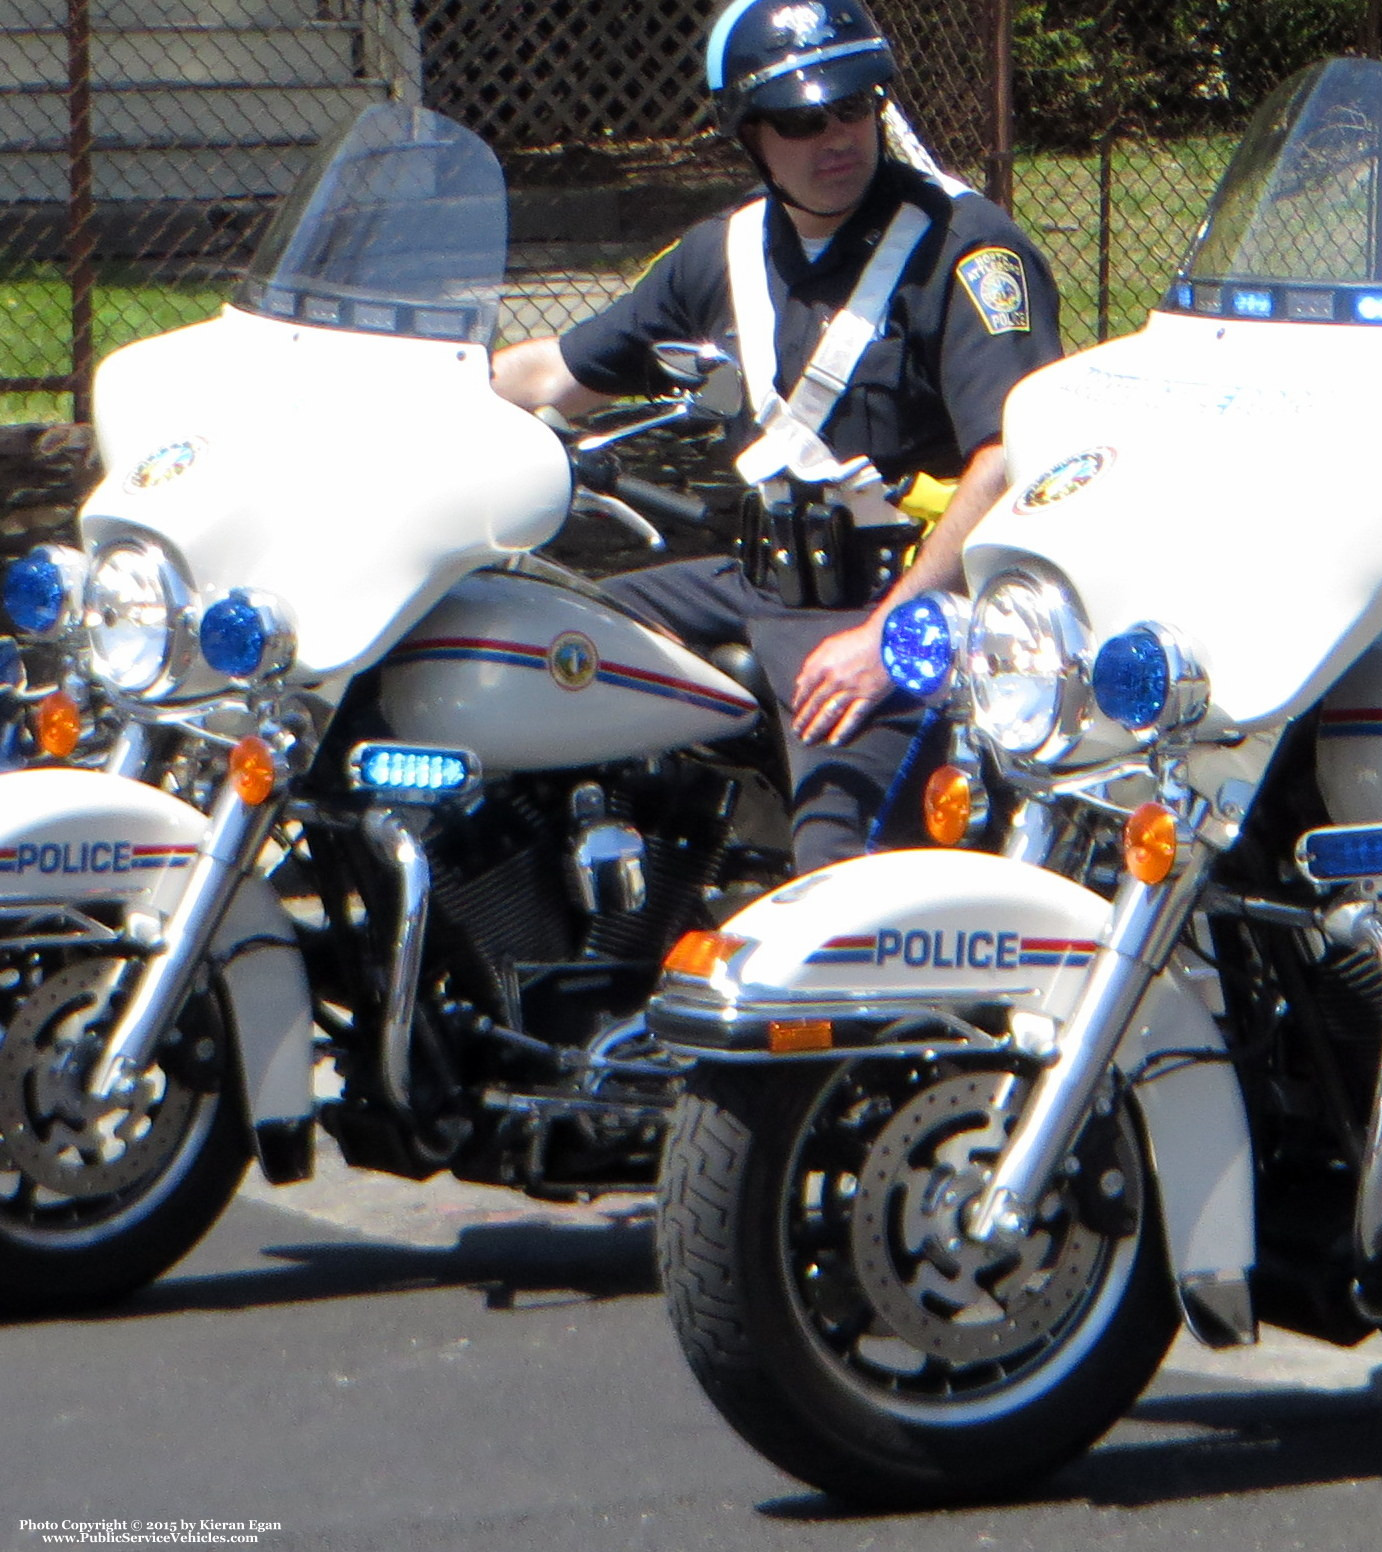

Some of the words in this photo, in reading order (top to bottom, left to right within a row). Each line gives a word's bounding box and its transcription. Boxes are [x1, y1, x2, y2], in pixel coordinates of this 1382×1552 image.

[991, 311, 1027, 329] POLICE
[18, 840, 132, 873] POLICE
[876, 928, 1019, 969] POLICE
